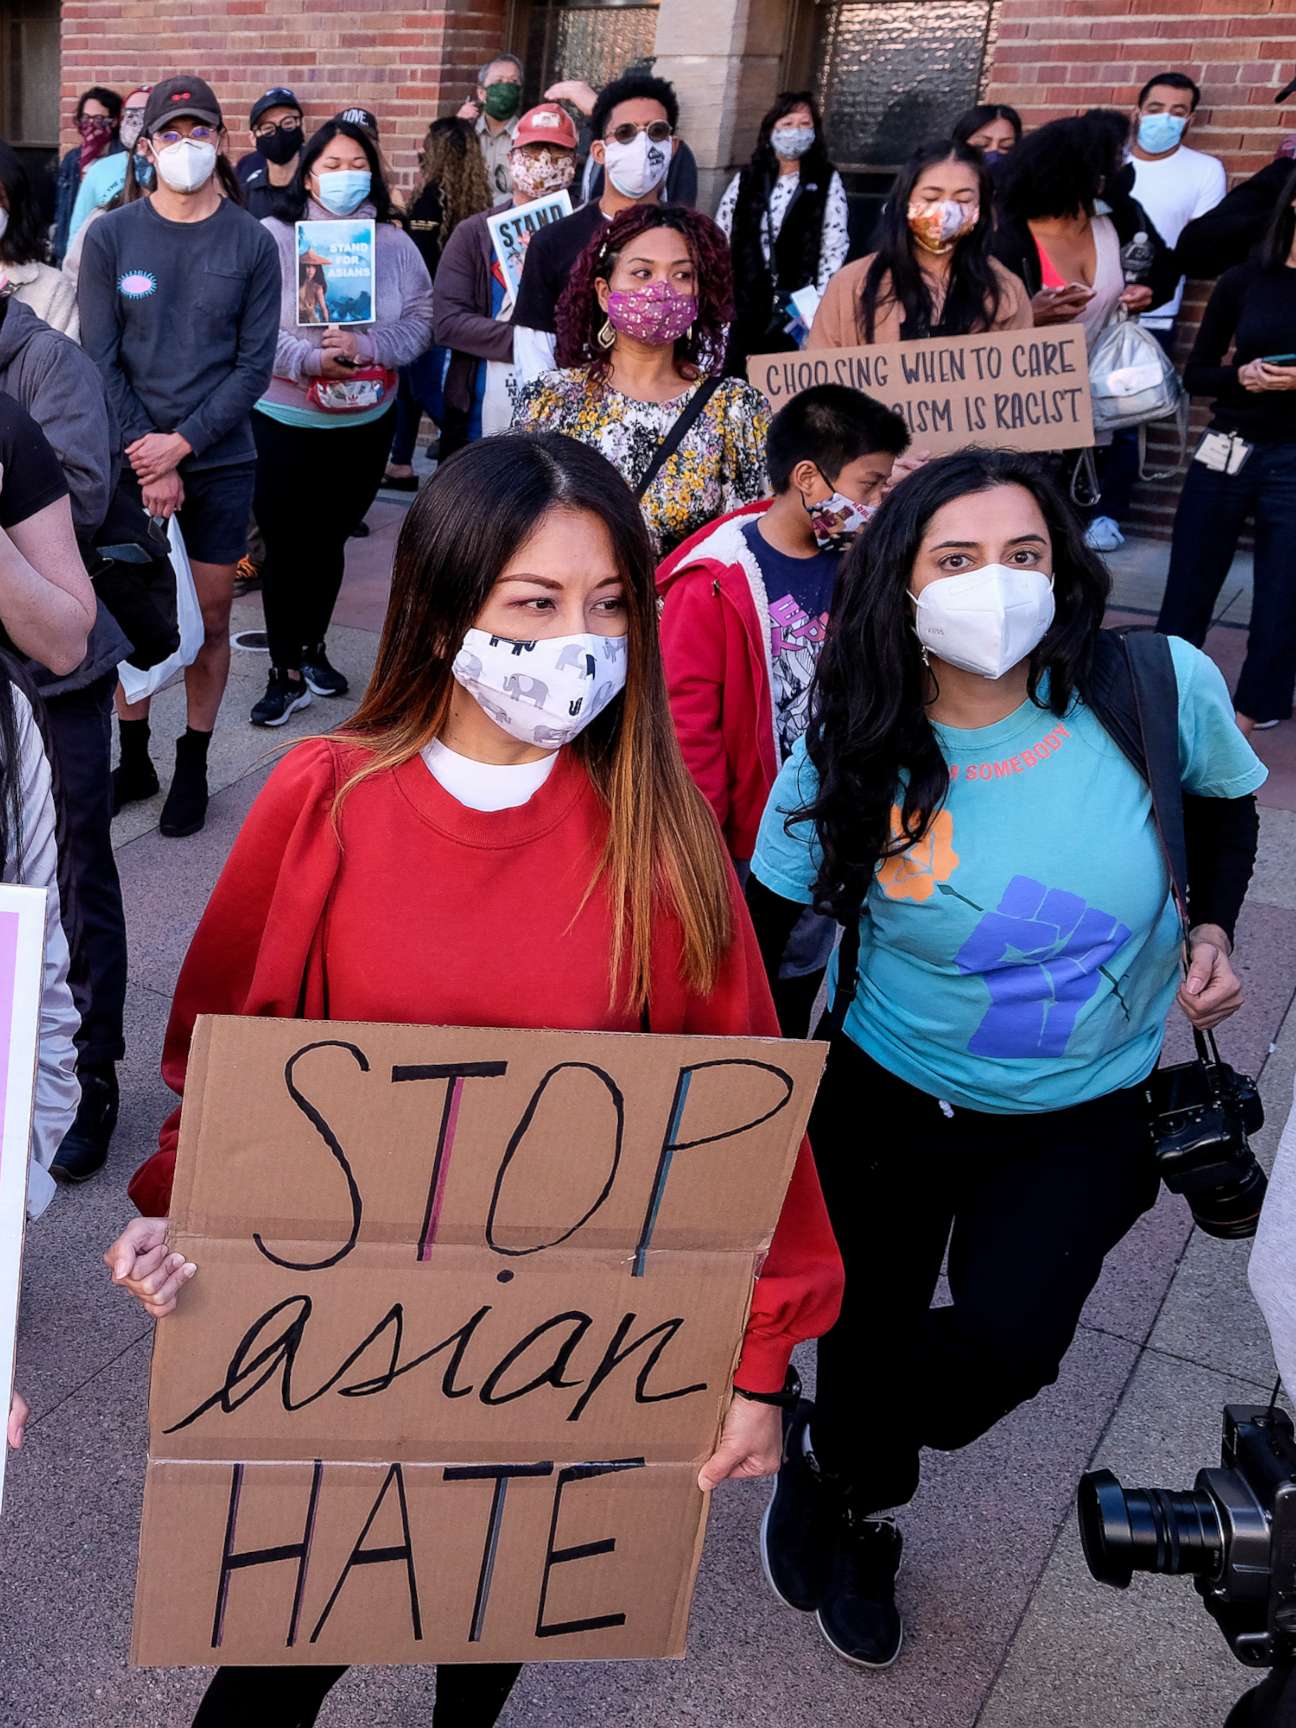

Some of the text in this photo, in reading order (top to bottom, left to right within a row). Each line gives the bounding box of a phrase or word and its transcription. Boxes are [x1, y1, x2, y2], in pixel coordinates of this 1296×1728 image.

[328, 268, 371, 277] ASIANS
[329, 243, 369, 253] STAND
[336, 255, 360, 265] FOR
[766, 339, 1075, 396] CHOOSING WHEN TO CARE
[965, 396, 987, 432] IS
[995, 387, 1083, 430] RACIST
[965, 722, 1072, 781] SOMEBODY
[252, 1039, 794, 1278] STOP
[162, 1270, 708, 1435] asian
[210, 1456, 646, 1649] HATE
